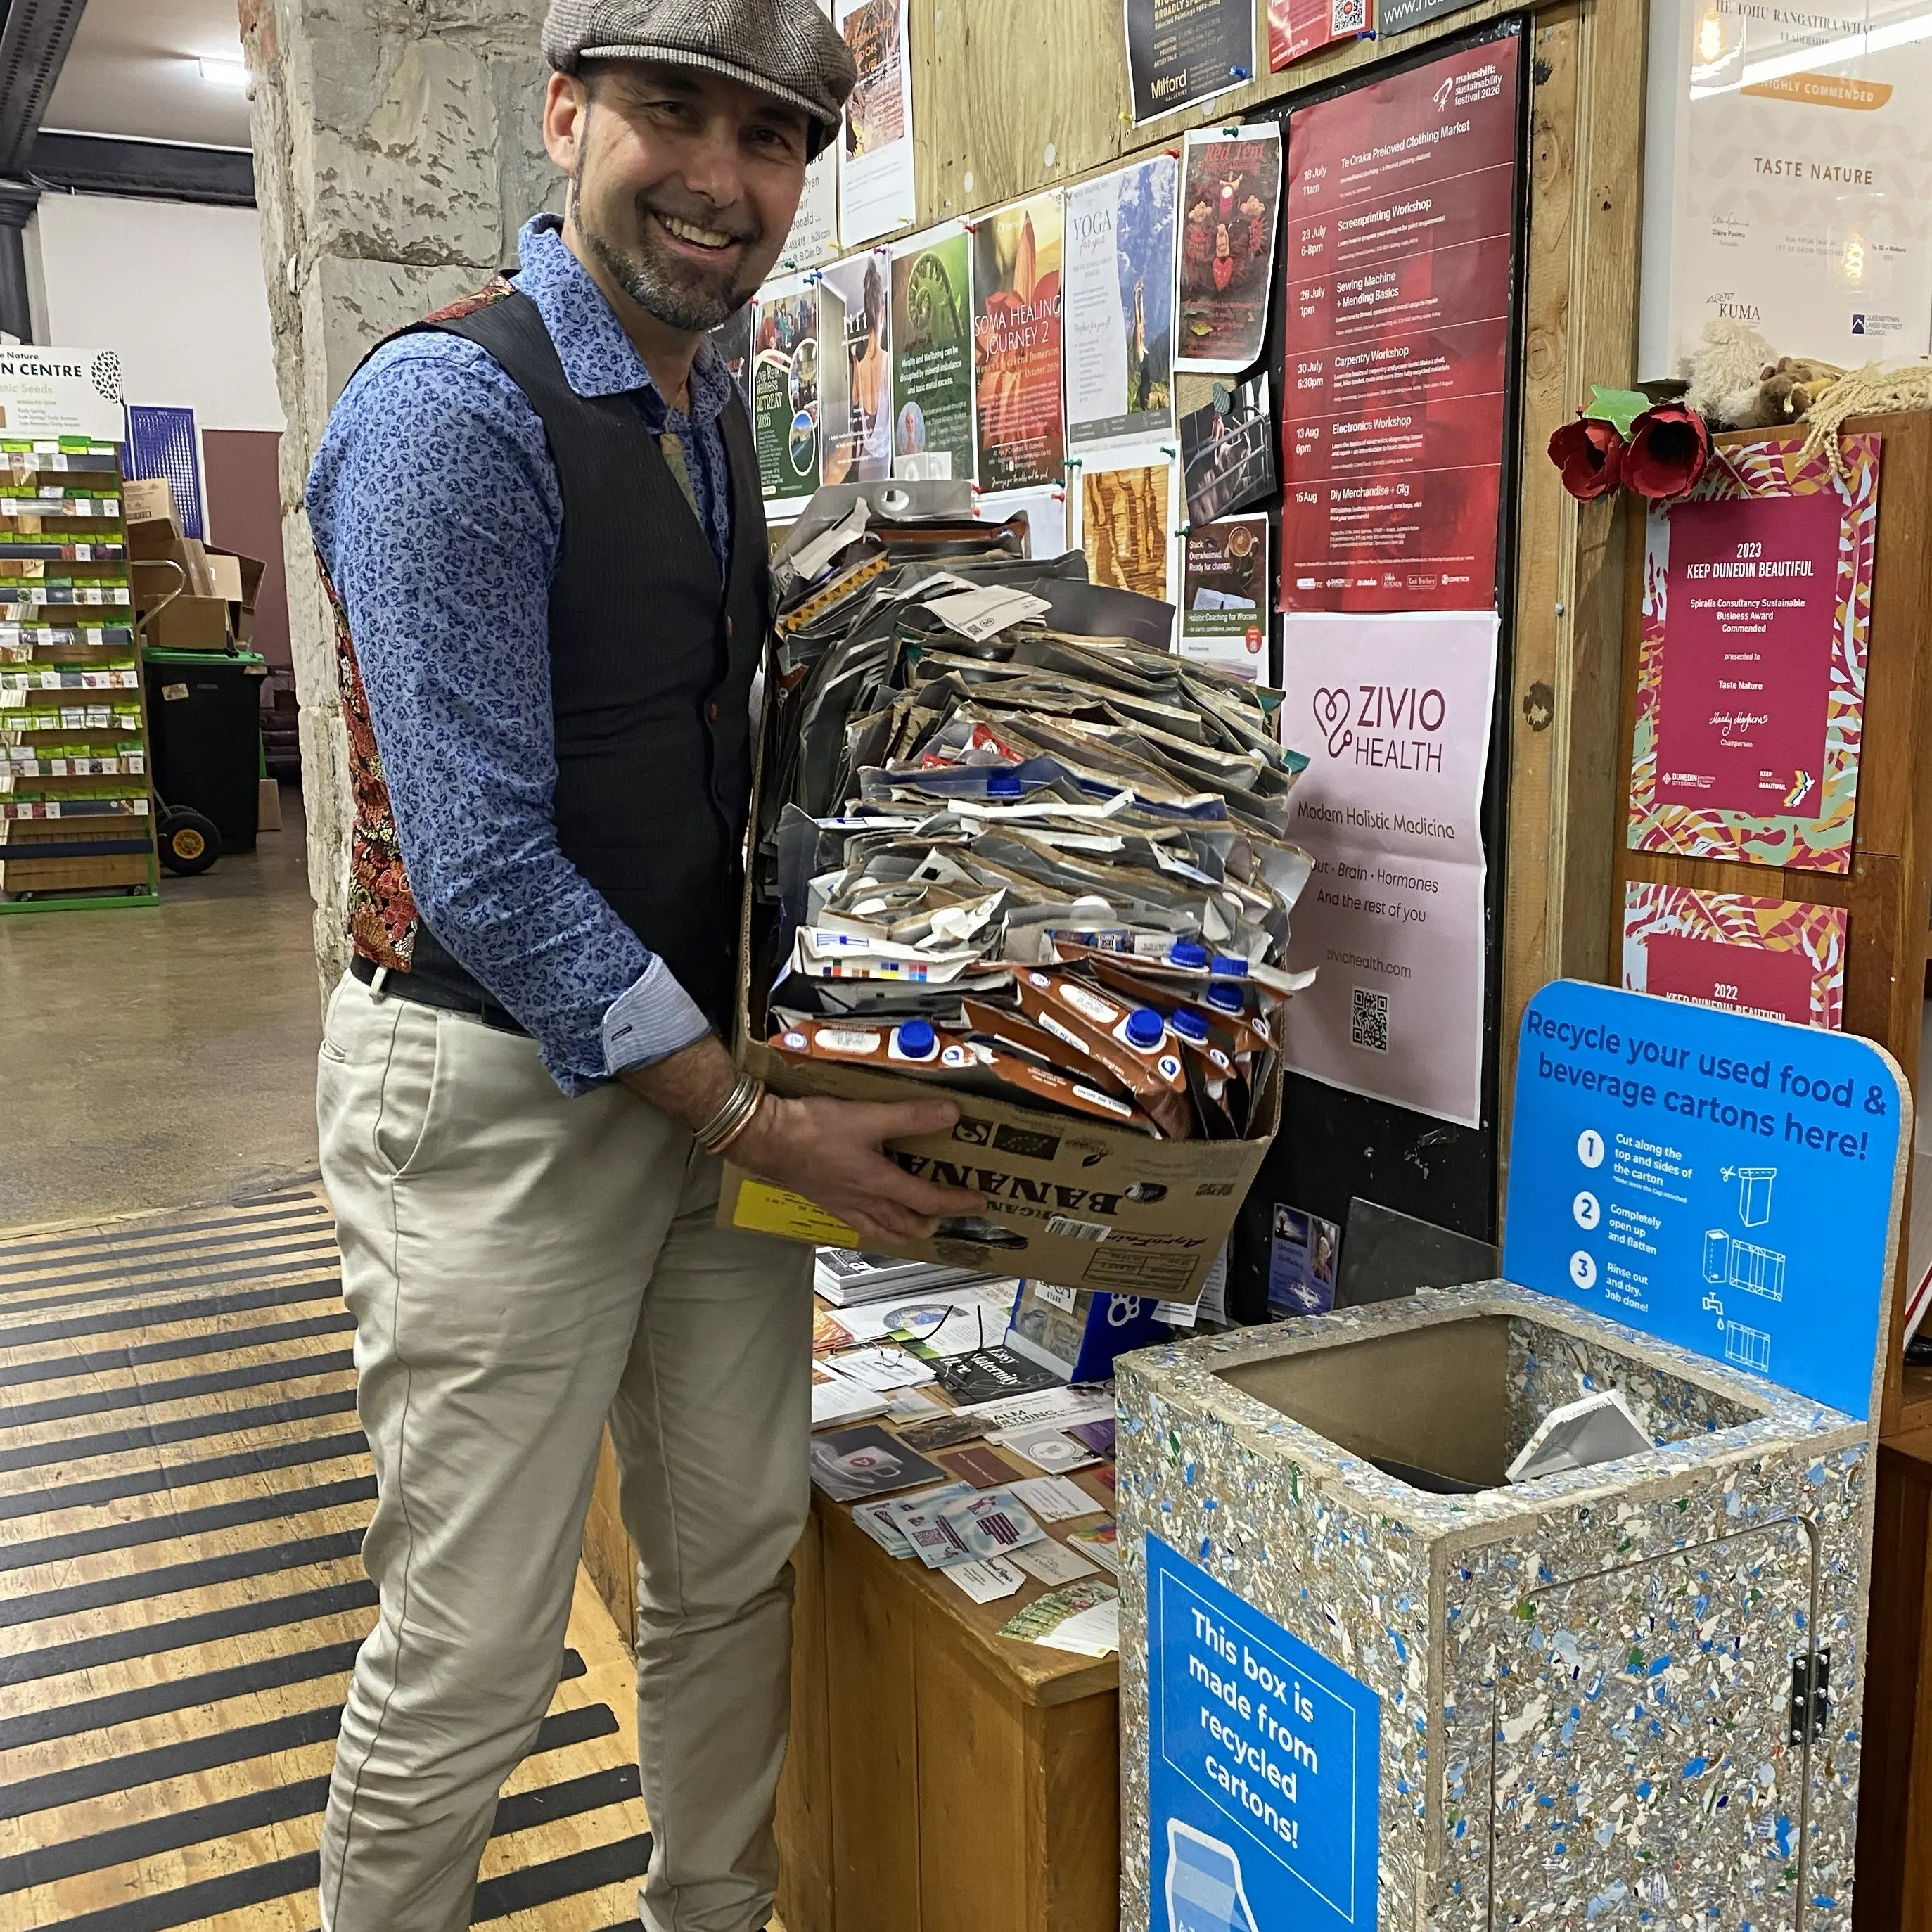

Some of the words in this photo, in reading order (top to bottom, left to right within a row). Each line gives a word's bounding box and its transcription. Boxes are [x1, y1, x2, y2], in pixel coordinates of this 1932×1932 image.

[1155, 3, 1184, 21] BROADLY
[1738, 4, 1770, 19] TOHU
[1774, 11, 1838, 32] RANGATIRA
[1151, 69, 1187, 99] Milford
[1455, 64, 1496, 84] makeshift:
[1454, 91, 1480, 106] festival
[1481, 85, 1501, 99] 2026
[1455, 74, 1503, 96] sustainability
[1805, 83, 1874, 103] COMMENDED
[1341, 156, 1350, 169] Te
[1350, 152, 1371, 167] Oraka
[1373, 141, 1405, 162] Preloved
[1406, 130, 1440, 148] Clothing
[1440, 119, 1470, 138] Market
[1304, 168, 1312, 180] 18
[1312, 165, 1327, 179] July
[1754, 158, 1802, 177] TASTE
[1811, 164, 1873, 185] NATURE
[1303, 184, 1320, 196] 11am
[1074, 209, 1112, 241] YOGA
[1338, 207, 1391, 231] Screenprinting
[1392, 198, 1432, 221] Workshop
[1301, 228, 1311, 241] 23
[1312, 225, 1326, 241] July
[1301, 243, 1323, 257] 6-8pm
[1336, 279, 1363, 293] Sewing
[1364, 271, 1395, 286] Machine
[1310, 287, 1325, 299] July
[1342, 293, 1374, 308] Mending
[1375, 287, 1399, 300] Basics
[975, 312, 1006, 337] SOMA
[1011, 295, 1061, 326] HEALING
[1300, 305, 1314, 317] 1pm
[1720, 303, 1761, 320] KUMA
[986, 328, 1037, 362] JOURNEY
[1041, 321, 1049, 343] 2
[1335, 354, 1370, 367] Carpentry
[1371, 346, 1409, 362] Workshop
[20, 364, 82, 377] CENTRE
[1298, 364, 1307, 374] 30
[1308, 361, 1323, 373] July
[21, 383, 53, 394] Seeds
[1298, 377, 1324, 390] 6:30pm
[757, 392, 782, 411] RETREAT
[1296, 428, 1305, 438] 13
[1305, 426, 1319, 438] Aug
[1333, 421, 1372, 435] Electronics
[1373, 415, 1412, 428] Workshop
[1296, 443, 1311, 455] 6pm
[1296, 492, 1303, 503] 15
[1304, 492, 1317, 504] Aug
[1331, 490, 1341, 501] Diy
[1341, 485, 1388, 499] Merchandise
[1396, 484, 1409, 495] Gig
[1736, 542, 1762, 558] 2023
[1189, 563, 1203, 572] Ready
[1687, 563, 1710, 579] KEEP
[1713, 561, 1756, 578] DUNEDIN
[1758, 561, 1814, 577] BEAUTIFUL
[1690, 599, 1715, 609] Spiralis
[1717, 599, 1760, 609] Consultancy
[1761, 599, 1805, 608] Sustainable
[1188, 613, 1205, 622] Holistic
[1717, 611, 1748, 620] Business
[1750, 611, 1774, 620] Award
[1722, 624, 1766, 633] Commended
[1724, 653, 1753, 661] presented
[1718, 680, 1736, 689] Taste
[1738, 681, 1763, 690] Nature
[1357, 686, 1445, 731] ZIVIO
[1720, 739, 1753, 748] Chairperson
[1355, 737, 1442, 773] HEALTH
[1672, 772, 1697, 781] DUNEDIN
[1759, 782, 1786, 791] BEAUTIFUL
[1298, 801, 1343, 822] Modern
[1347, 807, 1389, 830] Holistic
[1394, 814, 1454, 839] Medicine
[1338, 862, 1367, 881] Brain
[1378, 869, 1438, 893] Hormones
[1317, 888, 1340, 907] And
[1343, 894, 1362, 909] the
[1364, 900, 1386, 915] rest
[1388, 902, 1401, 918] of
[1402, 907, 1426, 923] you
[1326, 949, 1412, 978] ziviohealth.com
[1714, 983, 1738, 1001] 2022
[1527, 1009, 1620, 1054] Recycle
[1628, 1035, 1691, 1071] your
[1698, 1052, 1771, 1090] used
[1780, 1065, 1854, 1109] food
[1863, 1084, 1888, 1117] &
[1538, 1051, 1656, 1109] beverage
[1663, 1089, 1776, 1137] cartons
[1785, 1112, 1869, 1160] here!
[1616, 1133, 1634, 1148] Cut
[1634, 1137, 1663, 1158] along
[1665, 1145, 1682, 1161] the
[1613, 1162, 1630, 1177] the
[1631, 1168, 1663, 1186] carton
[1615, 1148, 1631, 1164] top
[1632, 1152, 1652, 1167] and
[1653, 1157, 1680, 1177] sides
[1681, 1167, 1693, 1180] of
[887, 1151, 1125, 1216] BANANA
[1581, 1198, 1592, 1220] 2
[1610, 1203, 1662, 1229] Completely
[1609, 1218, 1632, 1234] open
[1634, 1226, 1646, 1239] up
[1608, 1231, 1625, 1246] and
[1627, 1235, 1657, 1255] flatten
[1578, 1259, 1588, 1278] 3
[1607, 1262, 1629, 1279] Rinse
[1630, 1271, 1649, 1285] out
[1606, 1276, 1623, 1290] and
[1625, 1281, 1643, 1298] dry.
[1605, 1288, 1621, 1303] Job
[1623, 1294, 1649, 1312] done!
[994, 1409, 1027, 1421] ALM
[1191, 1607, 1238, 1665] This
[1243, 1645, 1287, 1706] box
[1293, 1682, 1314, 1724] is
[1189, 1654, 1251, 1720] made
[1258, 1705, 1319, 1776] from
[1201, 1706, 1298, 1804] recycled
[1205, 1755, 1299, 1850] cartons!
